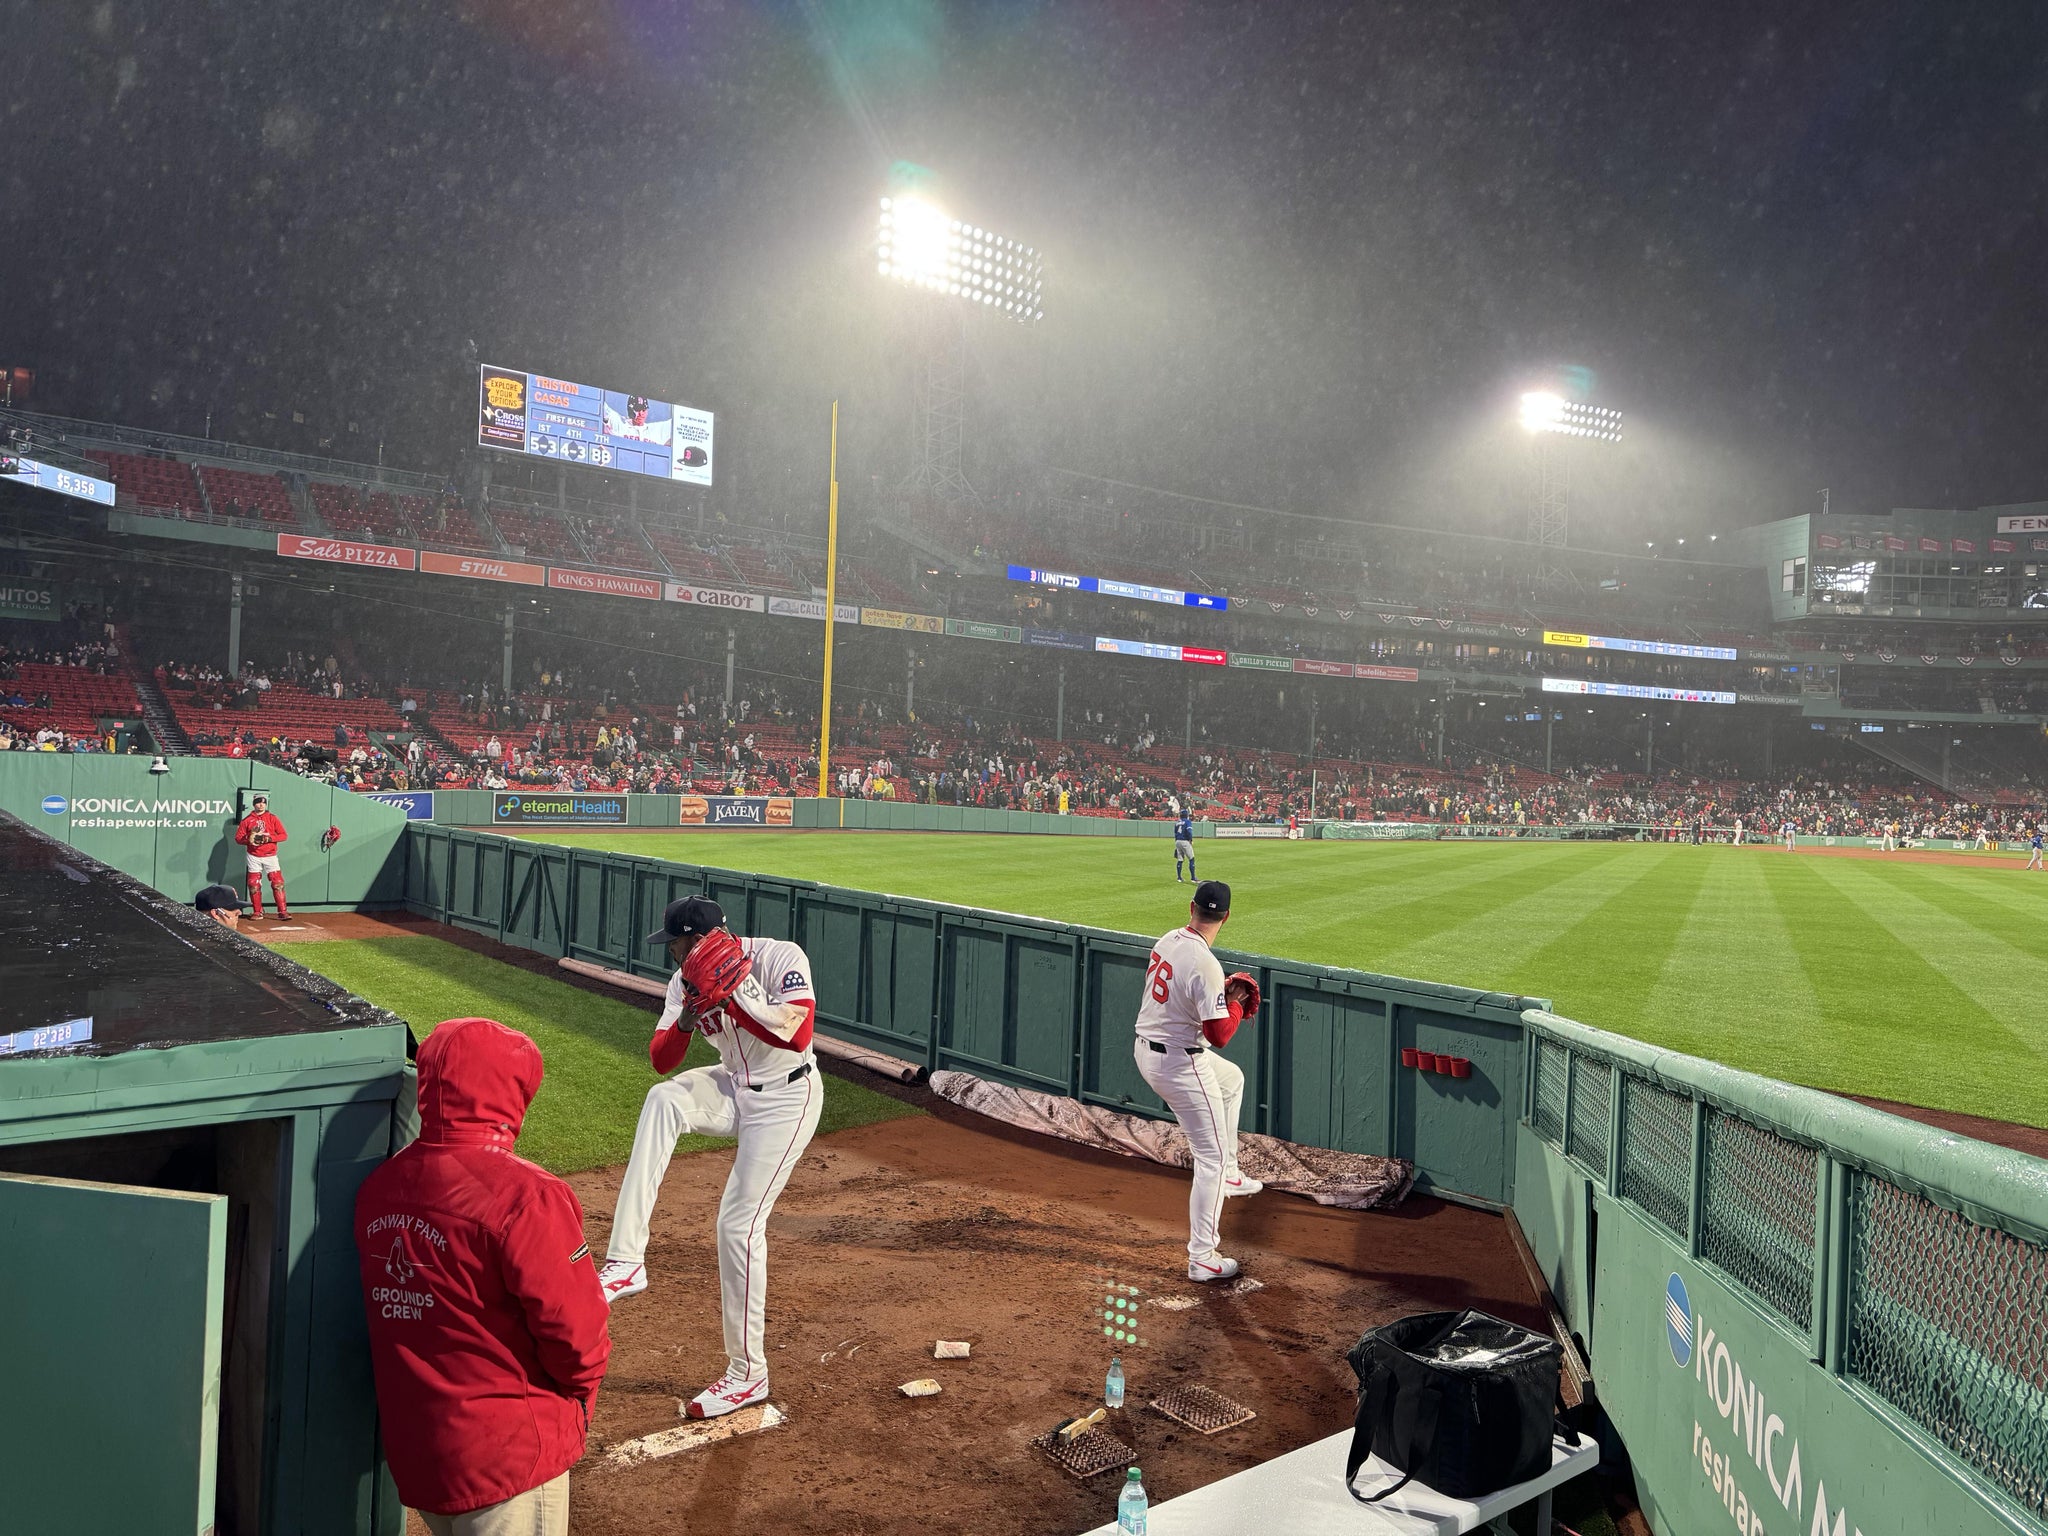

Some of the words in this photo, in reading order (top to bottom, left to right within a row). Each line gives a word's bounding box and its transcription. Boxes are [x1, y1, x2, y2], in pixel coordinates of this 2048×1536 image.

[490, 380, 518, 391] EXPLORE
[496, 389, 513, 398] YOUR
[535, 376, 579, 395] TRISTON
[490, 396, 518, 407] OPTIONS
[534, 391, 570, 407] CASAS
[546, 413, 566, 424] FIRST
[567, 416, 586, 427] BASE
[566, 428, 582, 439] 4TH
[594, 434, 610, 444] 7TH
[592, 448, 612, 464] BB
[57, 473, 95, 496] $5,358
[295, 540, 342, 559] Sal's
[345, 547, 399, 566] PIZZA
[459, 561, 508, 578] STIHL
[597, 578, 654, 595] HAWAIIAN
[1041, 572, 1080, 588] UNITED
[1104, 583, 1119, 592] PITCH
[11, 602, 50, 611] TEQUILA
[970, 625, 997, 634] HORNITOS
[1265, 660, 1290, 668] PICKLES
[71, 798, 150, 814] KONICA
[151, 799, 234, 815] MINOLTA
[714, 804, 760, 823] KAYEM
[71, 817, 207, 830] reshapework.com
[1146, 951, 1173, 1005] 76
[366, 1214, 415, 1239] FENWAY
[413, 1218, 448, 1252] PARK
[372, 1287, 435, 1307] GROUNDS
[382, 1303, 422, 1321] CREW
[1696, 1313, 1802, 1523] KONICA
